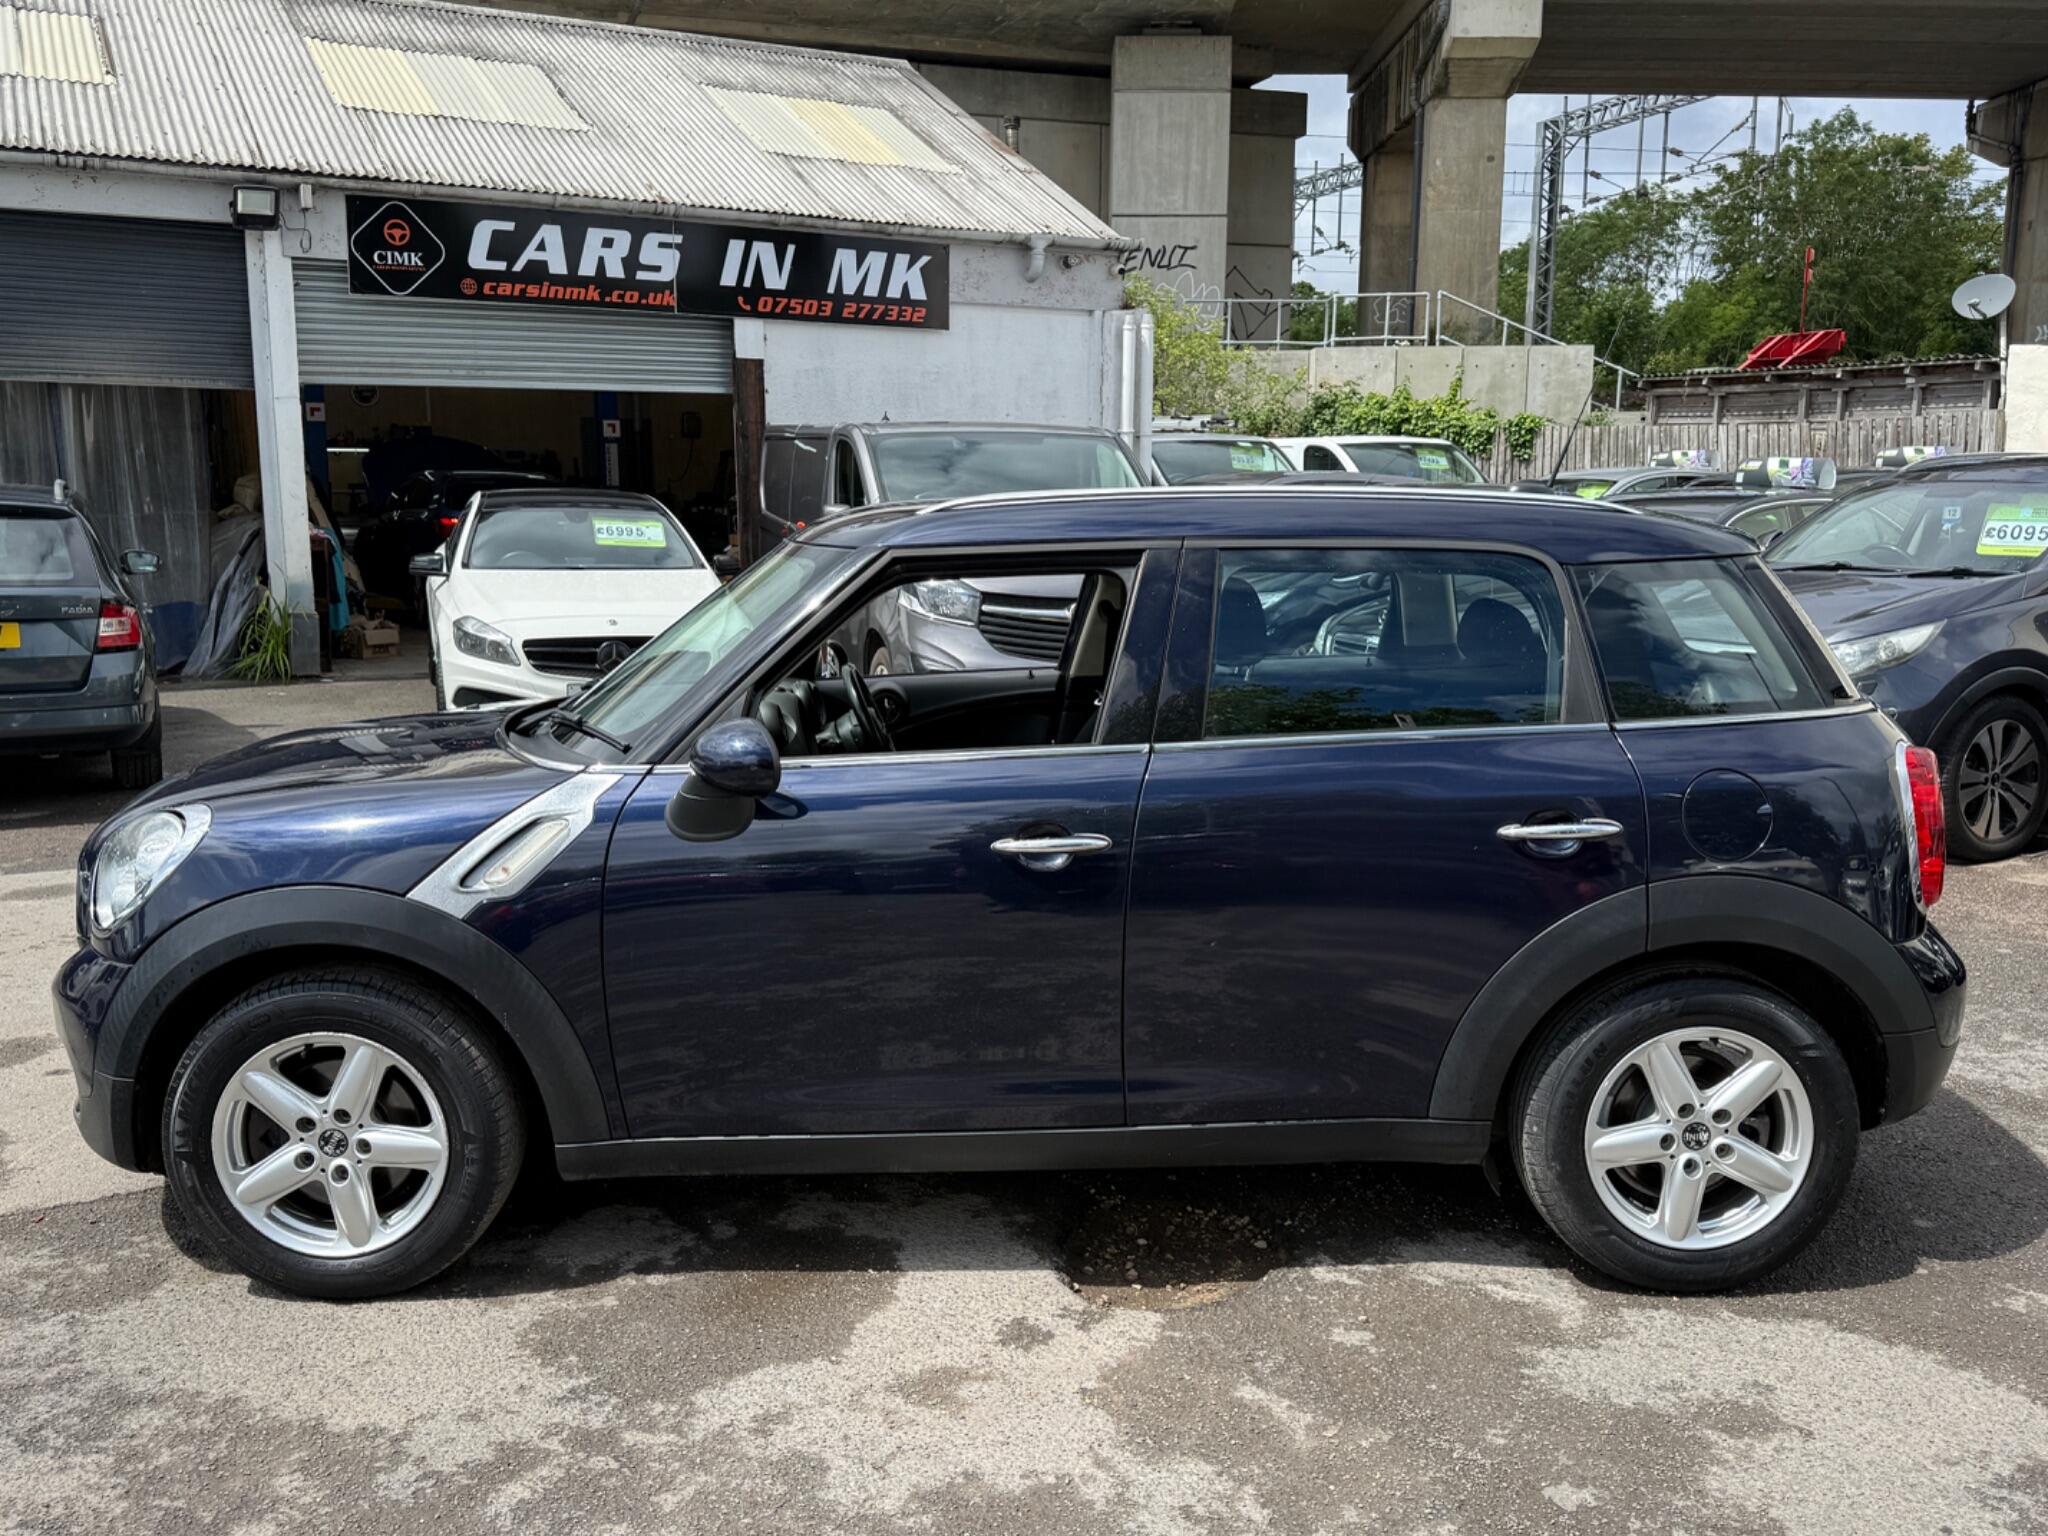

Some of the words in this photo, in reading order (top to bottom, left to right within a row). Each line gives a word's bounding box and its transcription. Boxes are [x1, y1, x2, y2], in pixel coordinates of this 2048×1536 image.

[373, 250, 424, 266] CIMK
[467, 219, 684, 282] CARS
[719, 239, 796, 290] IN
[826, 247, 932, 300] MK
[483, 280, 676, 306] carsinmk.co.uk
[757, 296, 833, 317] 07503
[842, 302, 927, 323] 277332
